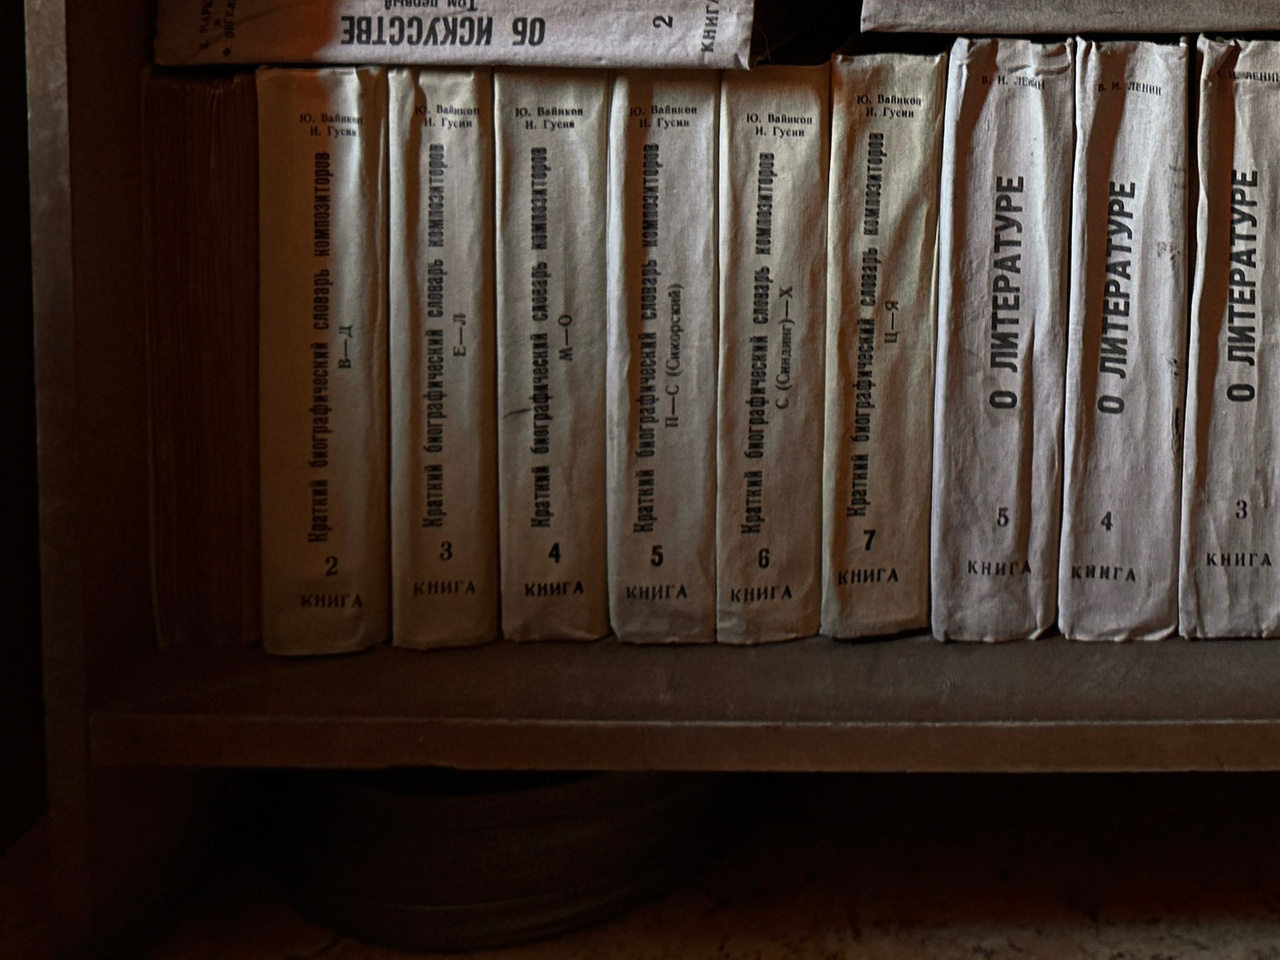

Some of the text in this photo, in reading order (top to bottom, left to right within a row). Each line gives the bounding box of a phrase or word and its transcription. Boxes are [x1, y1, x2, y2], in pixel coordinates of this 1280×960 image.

[340, 14, 547, 48] ОБ ИСКУССТВЕ
[652, 14, 674, 30] 2
[988, 174, 1024, 411] О ЛИТЕРАТУРЕ
[1226, 169, 1259, 403] О ЛИТЕРАТУРЕ
[1097, 180, 1137, 415] О ЛИТЕРАТУРЕ
[452, 312, 468, 358] Е—Л
[337, 324, 354, 369] В—Д
[664, 283, 685, 429] П—С (Сикорский)
[996, 507, 1010, 528] 5
[1235, 498, 1249, 520] 3
[1100, 510, 1114, 531] 4
[863, 529, 876, 552] 7
[440, 541, 454, 562] 3
[547, 542, 562, 564] 4
[650, 544, 664, 567] 5
[756, 546, 770, 570] 6
[1206, 551, 1273, 568] КНИГА
[324, 556, 339, 577] 2
[837, 567, 899, 586] КНИГА
[966, 559, 1032, 577] КНИГА
[1070, 564, 1136, 582] КНИГА
[412, 580, 477, 597] КНИГА
[524, 580, 585, 598] КНИГА
[626, 583, 688, 601] КНИГА
[729, 583, 793, 603] КНИГА
[300, 593, 364, 609] КНИГА
